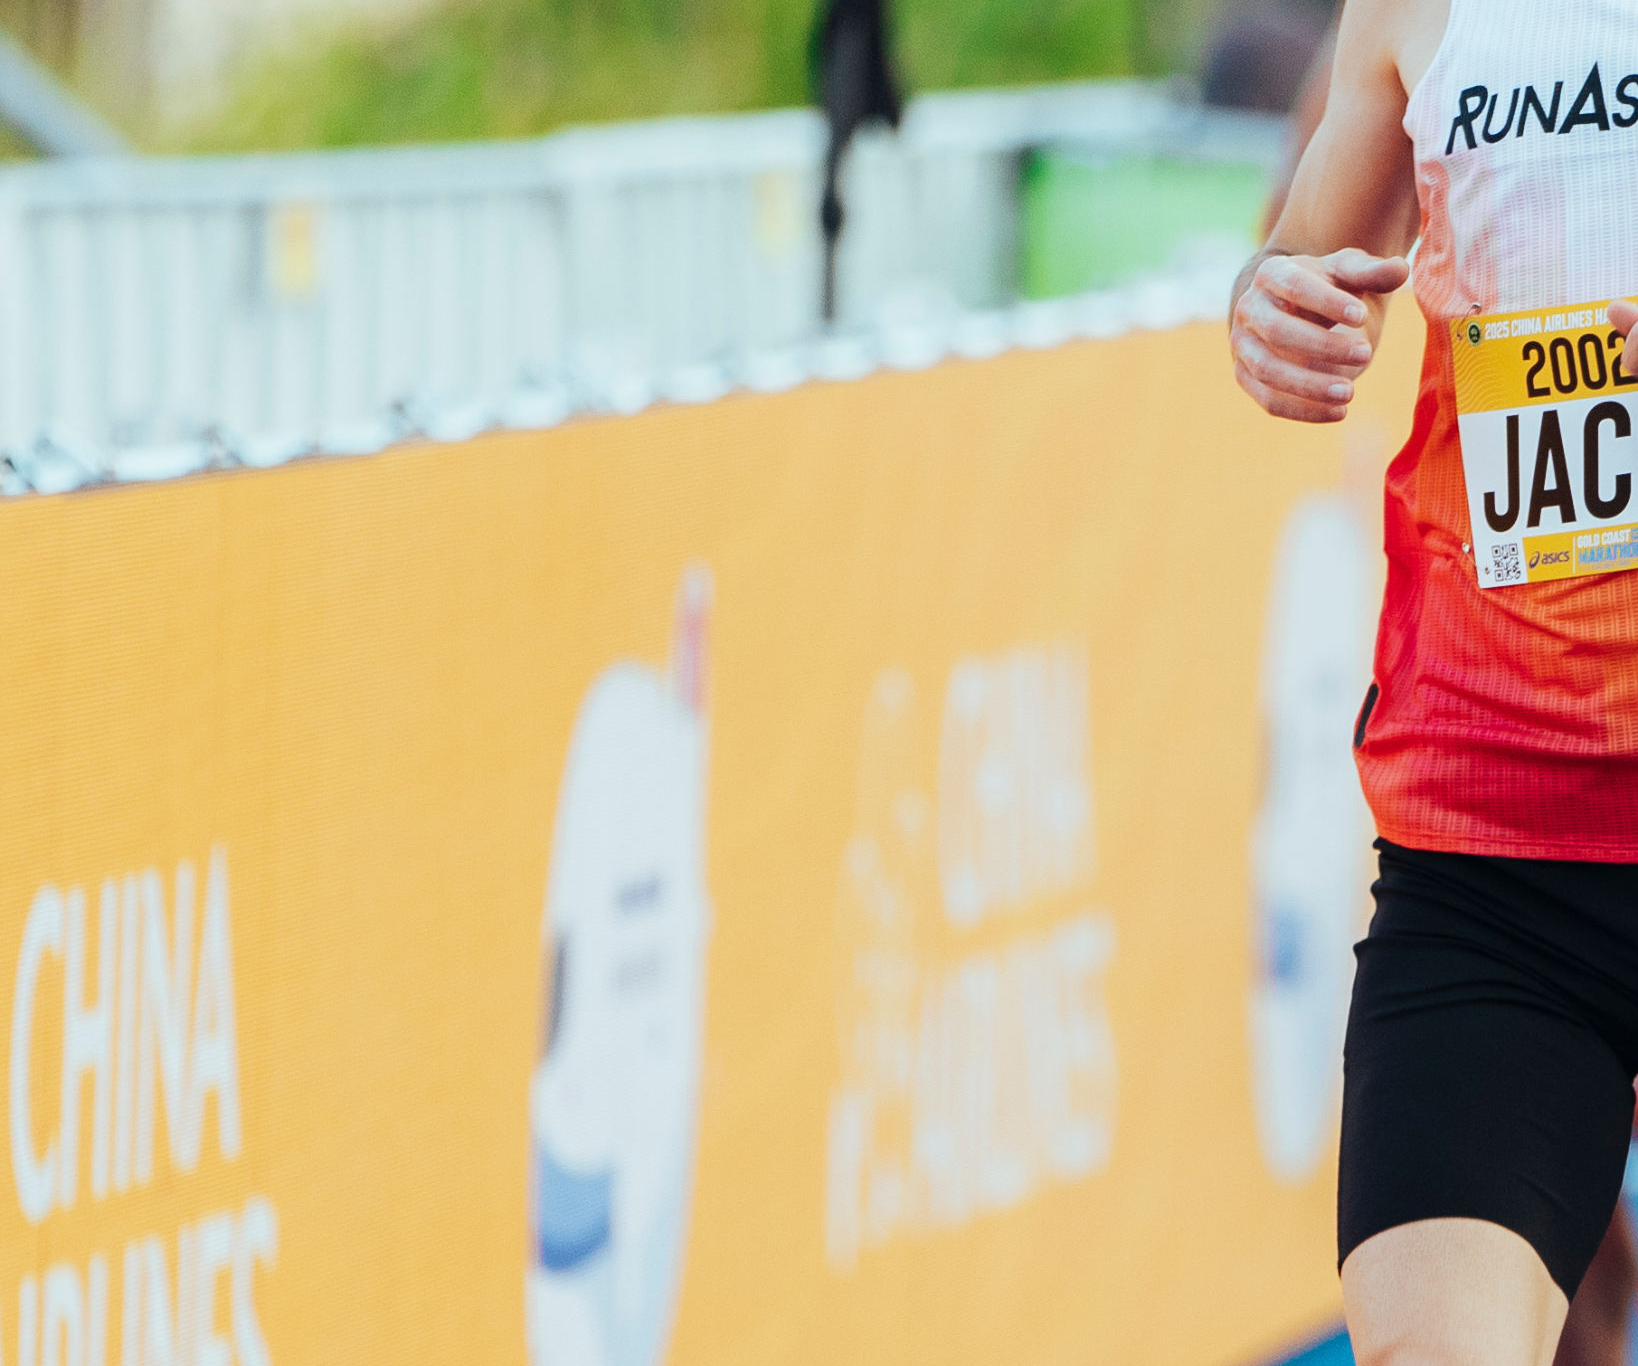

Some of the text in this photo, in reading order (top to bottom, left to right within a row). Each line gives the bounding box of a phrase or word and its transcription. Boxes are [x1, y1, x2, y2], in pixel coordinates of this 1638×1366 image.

[1484, 320, 1510, 341] 2025
[1511, 316, 1542, 338] CHINA
[1544, 310, 1593, 333] AIRLINES
[1577, 533, 1601, 549] GOLD
[1601, 528, 1632, 546] COAST
[1541, 550, 1570, 566] asics
[9, 839, 242, 1226] CHINA
